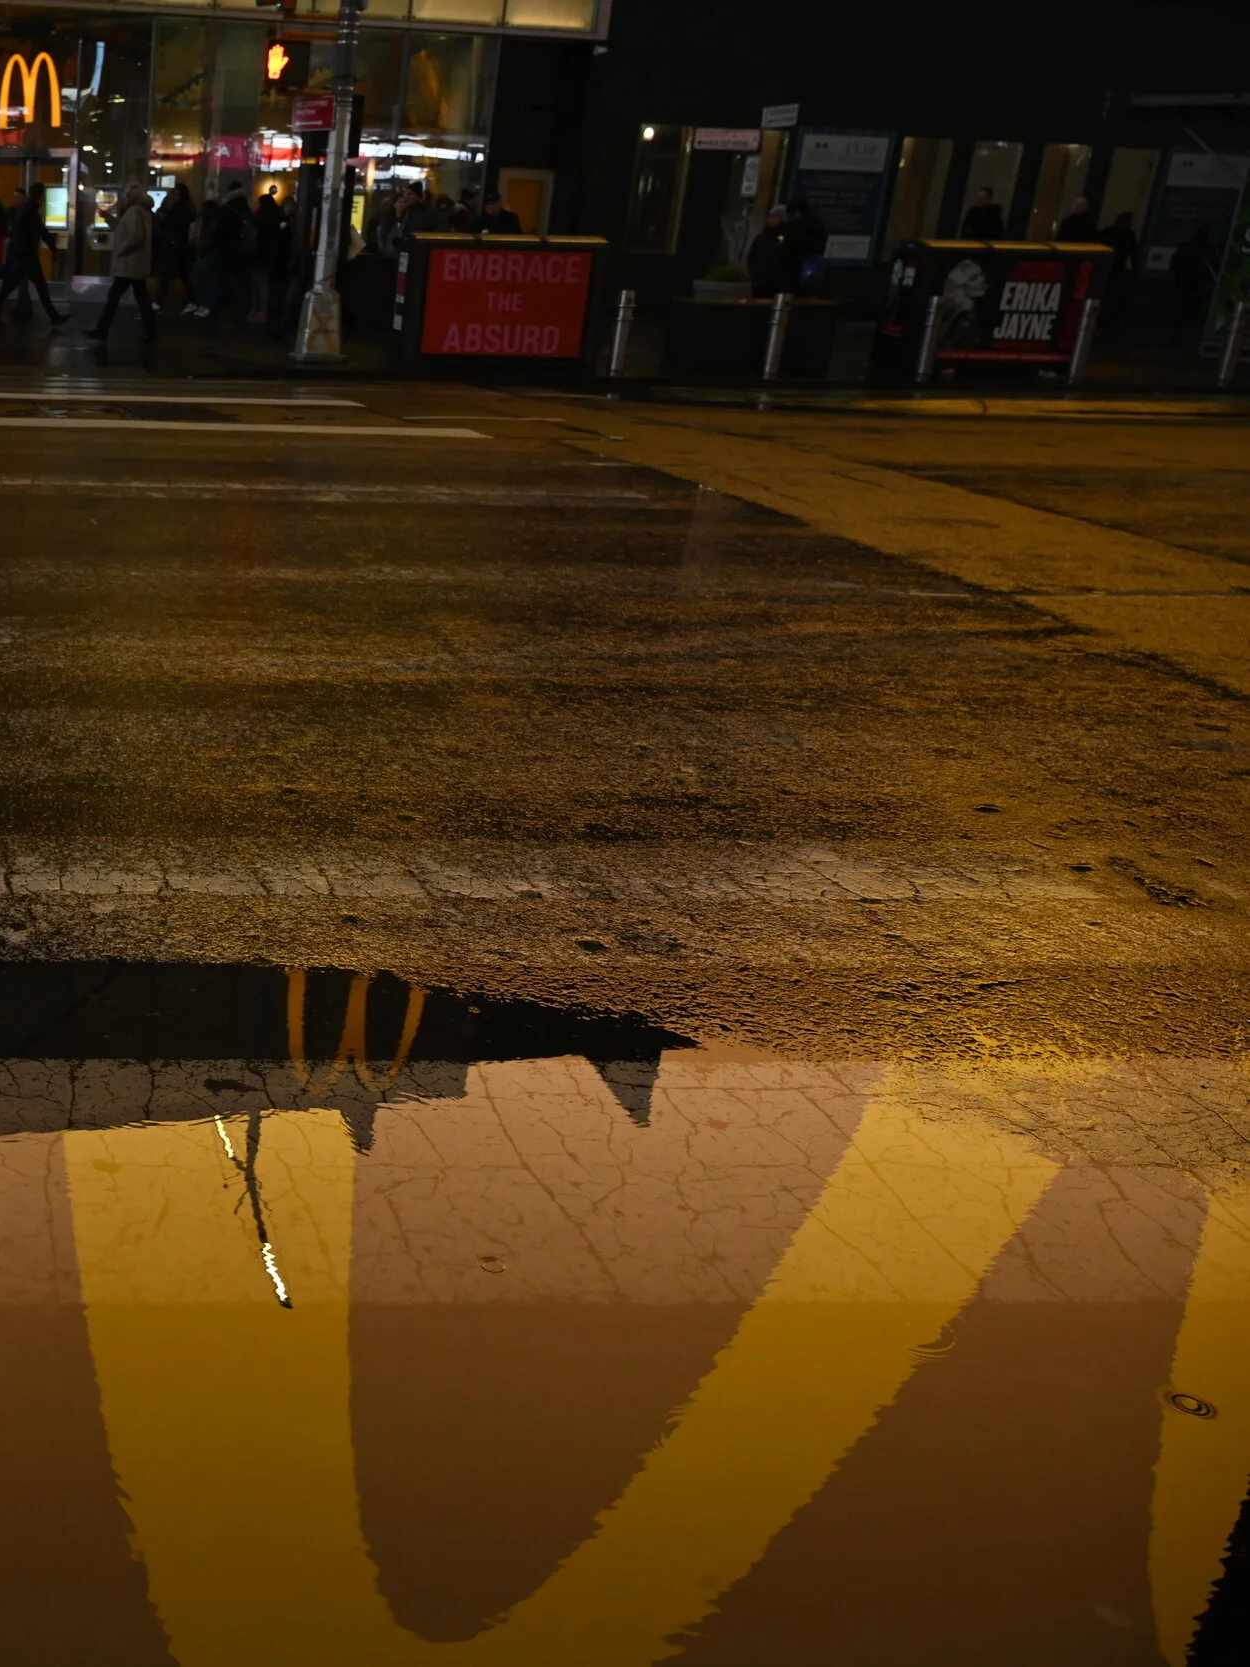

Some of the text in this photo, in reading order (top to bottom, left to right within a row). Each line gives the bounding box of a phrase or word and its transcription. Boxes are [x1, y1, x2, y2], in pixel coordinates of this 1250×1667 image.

[442, 253, 581, 284] EMBRACE
[485, 291, 524, 312] THE
[999, 281, 1062, 313] ERIKA
[442, 323, 561, 354] ABSURD
[992, 312, 1057, 341] JAYNE
